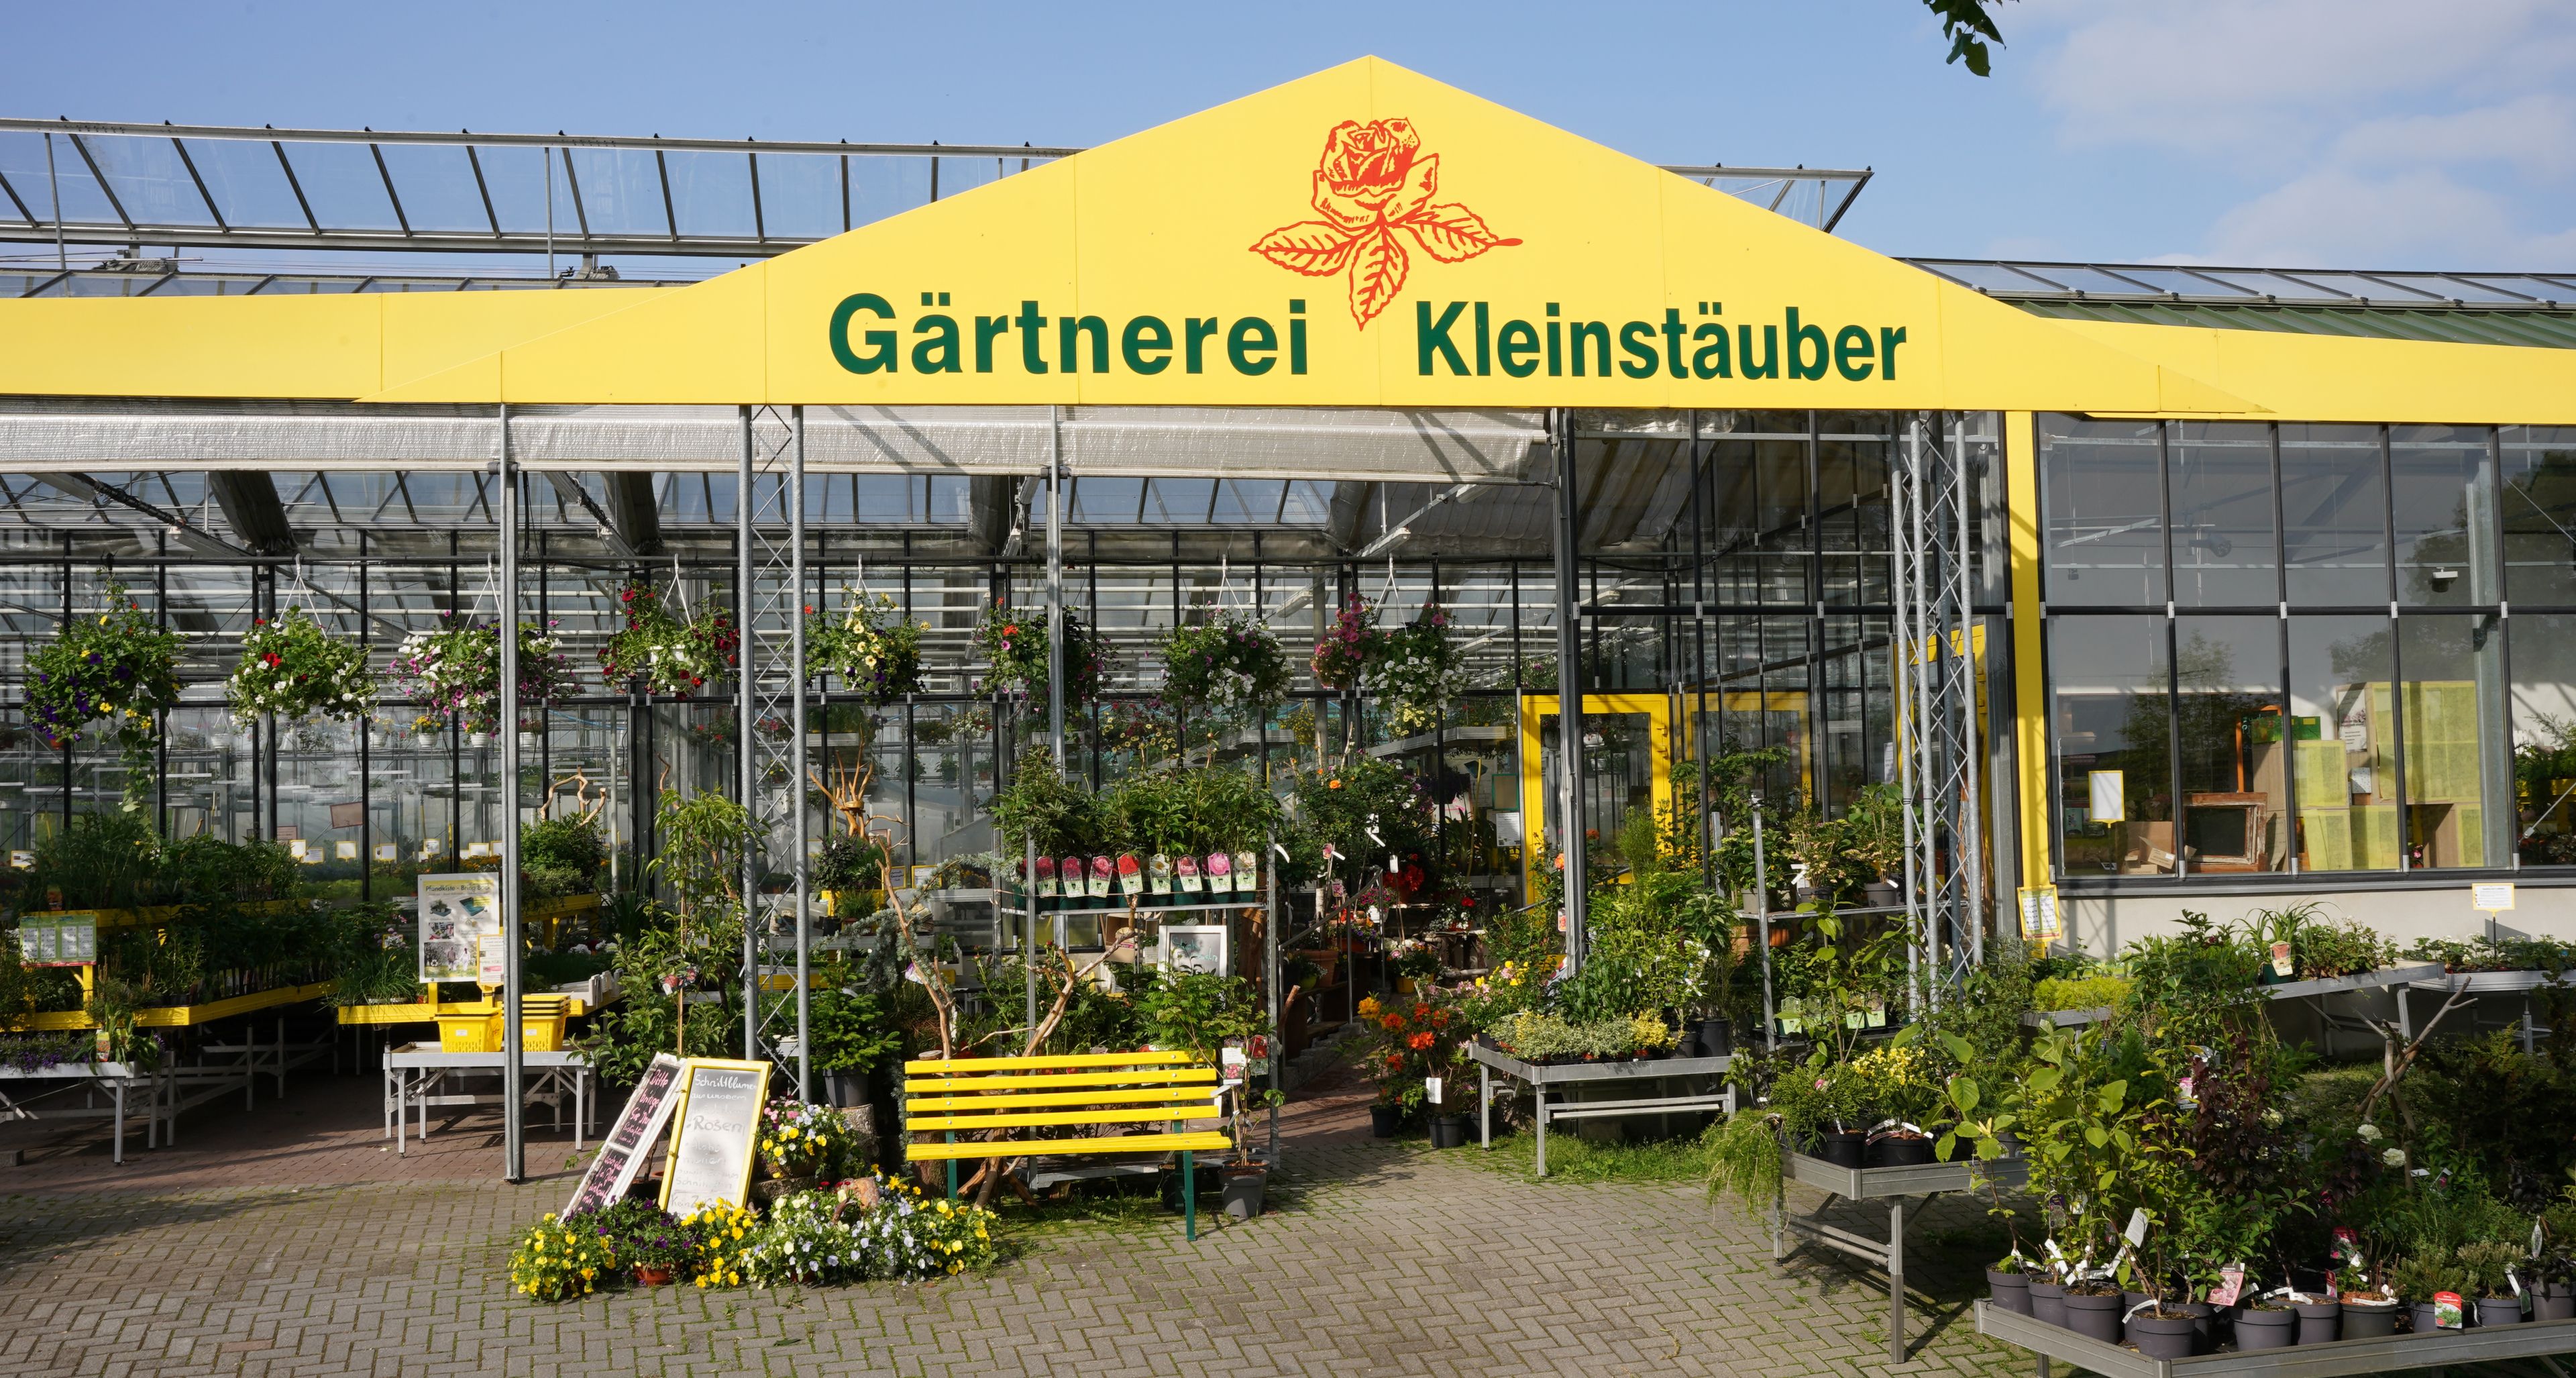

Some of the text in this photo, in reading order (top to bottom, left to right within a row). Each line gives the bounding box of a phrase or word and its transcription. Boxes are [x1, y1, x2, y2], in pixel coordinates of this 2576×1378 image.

[828, 293, 1906, 381] Gärtnerei Kleinstäuber
[649, 1069, 669, 1088] Bitte
[695, 1073, 758, 1090] Schnittblumen
